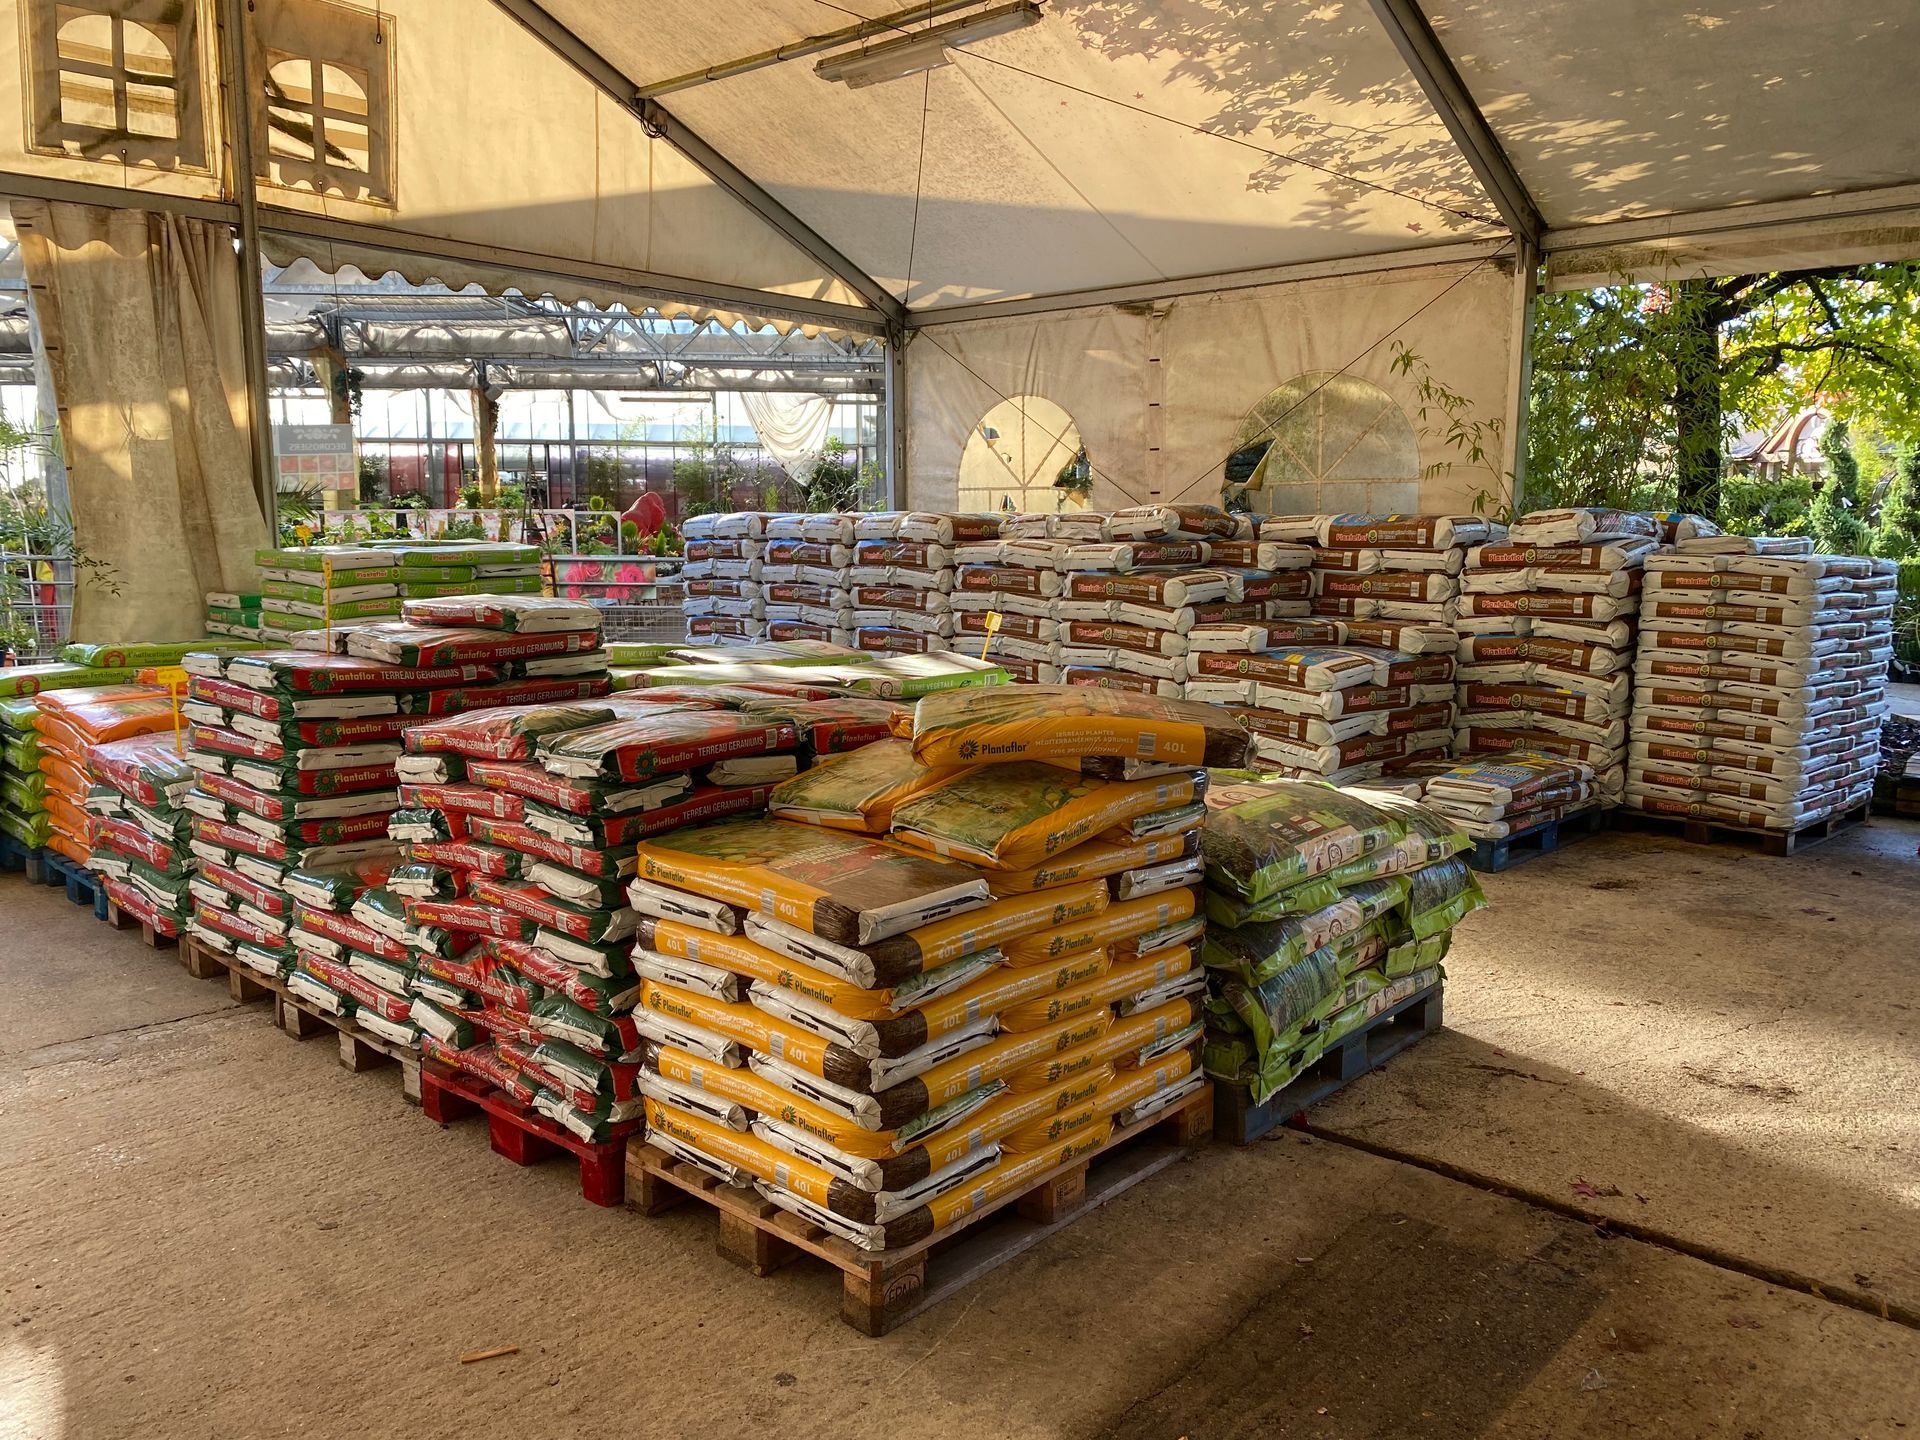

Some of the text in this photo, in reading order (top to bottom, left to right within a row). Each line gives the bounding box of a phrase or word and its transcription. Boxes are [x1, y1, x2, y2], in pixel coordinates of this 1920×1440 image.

[1336, 533, 1368, 541] Plantaflor
[1488, 553, 1525, 562] Plantaflor
[356, 571, 387, 579] Plantaflor
[1676, 577, 1710, 585] Plantaflor
[1330, 581, 1361, 590] Plantaflor
[359, 602, 391, 610] Plantaflor
[1482, 600, 1518, 608] Plantaflor
[1671, 607, 1705, 615] Plantaflor
[1672, 637, 1706, 645] Plantaflor
[451, 641, 565, 660] Plantaflor TERREAU GERANIUMS
[1482, 647, 1518, 656] Plantaflor
[1206, 660, 1239, 670] Plantaflor
[329, 672, 375, 681] Plantaflor
[381, 671, 414, 680] TERREAU
[416, 668, 459, 680] GERANIUMS
[461, 698, 500, 707] Plantaflor
[506, 694, 536, 704] TERREAU
[1476, 695, 1511, 704] Plantaflor
[336, 725, 382, 736] Plantaflor
[1055, 729, 1115, 738] TERREAU PLANTES
[444, 737, 467, 749] TERREAU
[842, 734, 876, 744] Plantaflor
[653, 736, 764, 766] Plantaflor TERREAU GERANIUMS
[982, 743, 1027, 756] Plantaflor
[1163, 741, 1187, 754] 40L
[335, 772, 379, 783] Plantaflor
[639, 796, 750, 833] Plantaflor TERREAU GERANIUMS
[338, 821, 383, 833] Plantaflor
[520, 836, 540, 849] TERREAU
[1162, 844, 1174, 855] 40L
[656, 866, 686, 884] Plantaflor
[1049, 867, 1079, 881] Plantaflor
[415, 911, 438, 921] Plantaflor
[504, 897, 526, 913] TERREAU
[524, 904, 555, 924] GERANIUMS
[780, 902, 799, 918] 40L
[1067, 902, 1096, 917] Plantaflor
[1173, 905, 1185, 917] 40L
[666, 940, 682, 952] 40L
[1065, 934, 1094, 951] Plantaflor
[938, 945, 956, 959] 40L
[1070, 964, 1099, 982] Plantaflor
[795, 981, 834, 1005] Plantaflor
[662, 1000, 692, 1018] Plantaflor
[1062, 996, 1092, 1014] Plantaflor
[943, 1014, 960, 1030] 40L
[1170, 1016, 1182, 1028] 40L
[1071, 1027, 1099, 1045] Plantaflor
[789, 1047, 808, 1064] 40L
[1063, 1057, 1092, 1075] Plantaflor
[1170, 1066, 1183, 1079] 40L
[670, 1066, 686, 1080] 40L
[944, 1082, 962, 1098] 40L
[1071, 1084, 1099, 1103] Plantaflor
[1064, 1112, 1093, 1132] Plantaflor
[667, 1121, 697, 1143] Plantaflor
[798, 1117, 836, 1143] Plantaflor
[1073, 1137, 1101, 1158] Plantaflor
[945, 1147, 963, 1163] 40L
[793, 1179, 813, 1196] 40L
